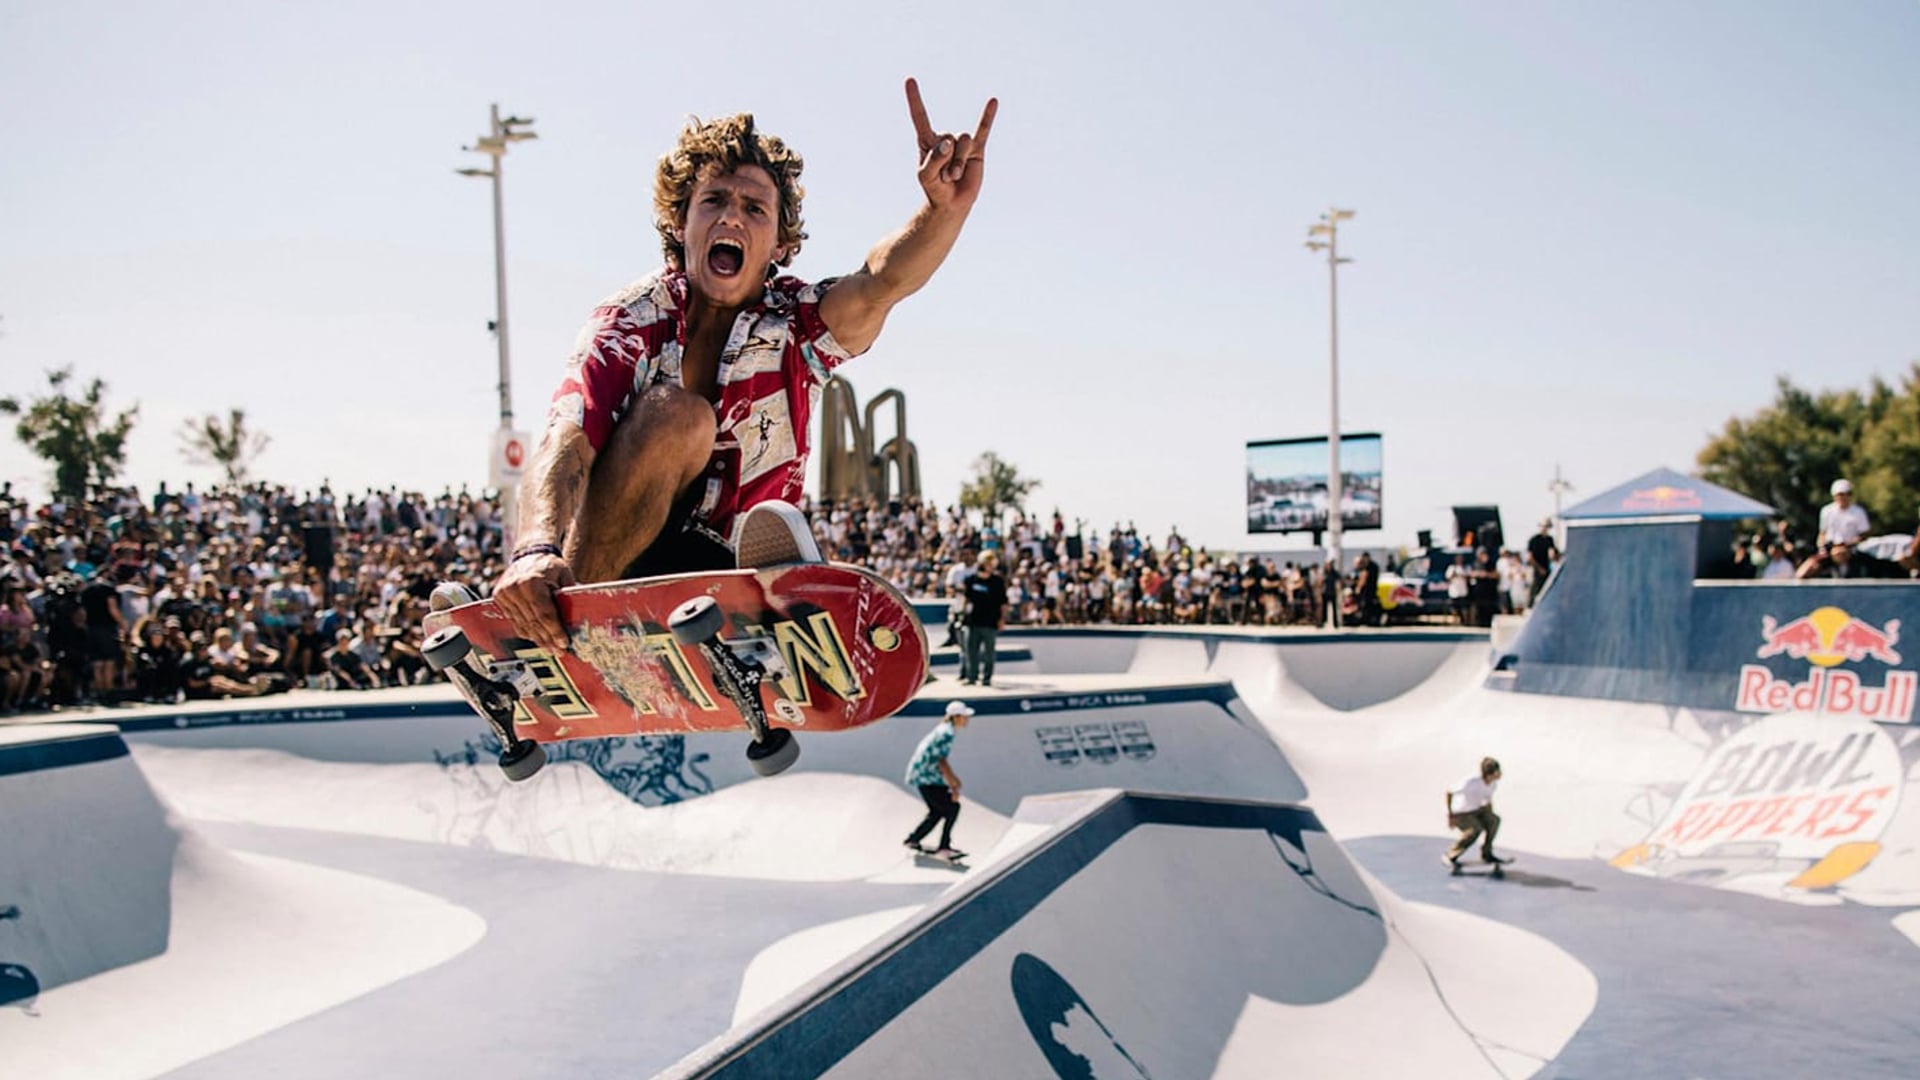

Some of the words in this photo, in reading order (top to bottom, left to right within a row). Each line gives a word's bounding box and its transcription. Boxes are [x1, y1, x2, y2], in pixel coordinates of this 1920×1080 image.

[1740, 666, 1822, 711] Red
[1825, 671, 1913, 719] Bull
[1692, 732, 1877, 798] BOWL
